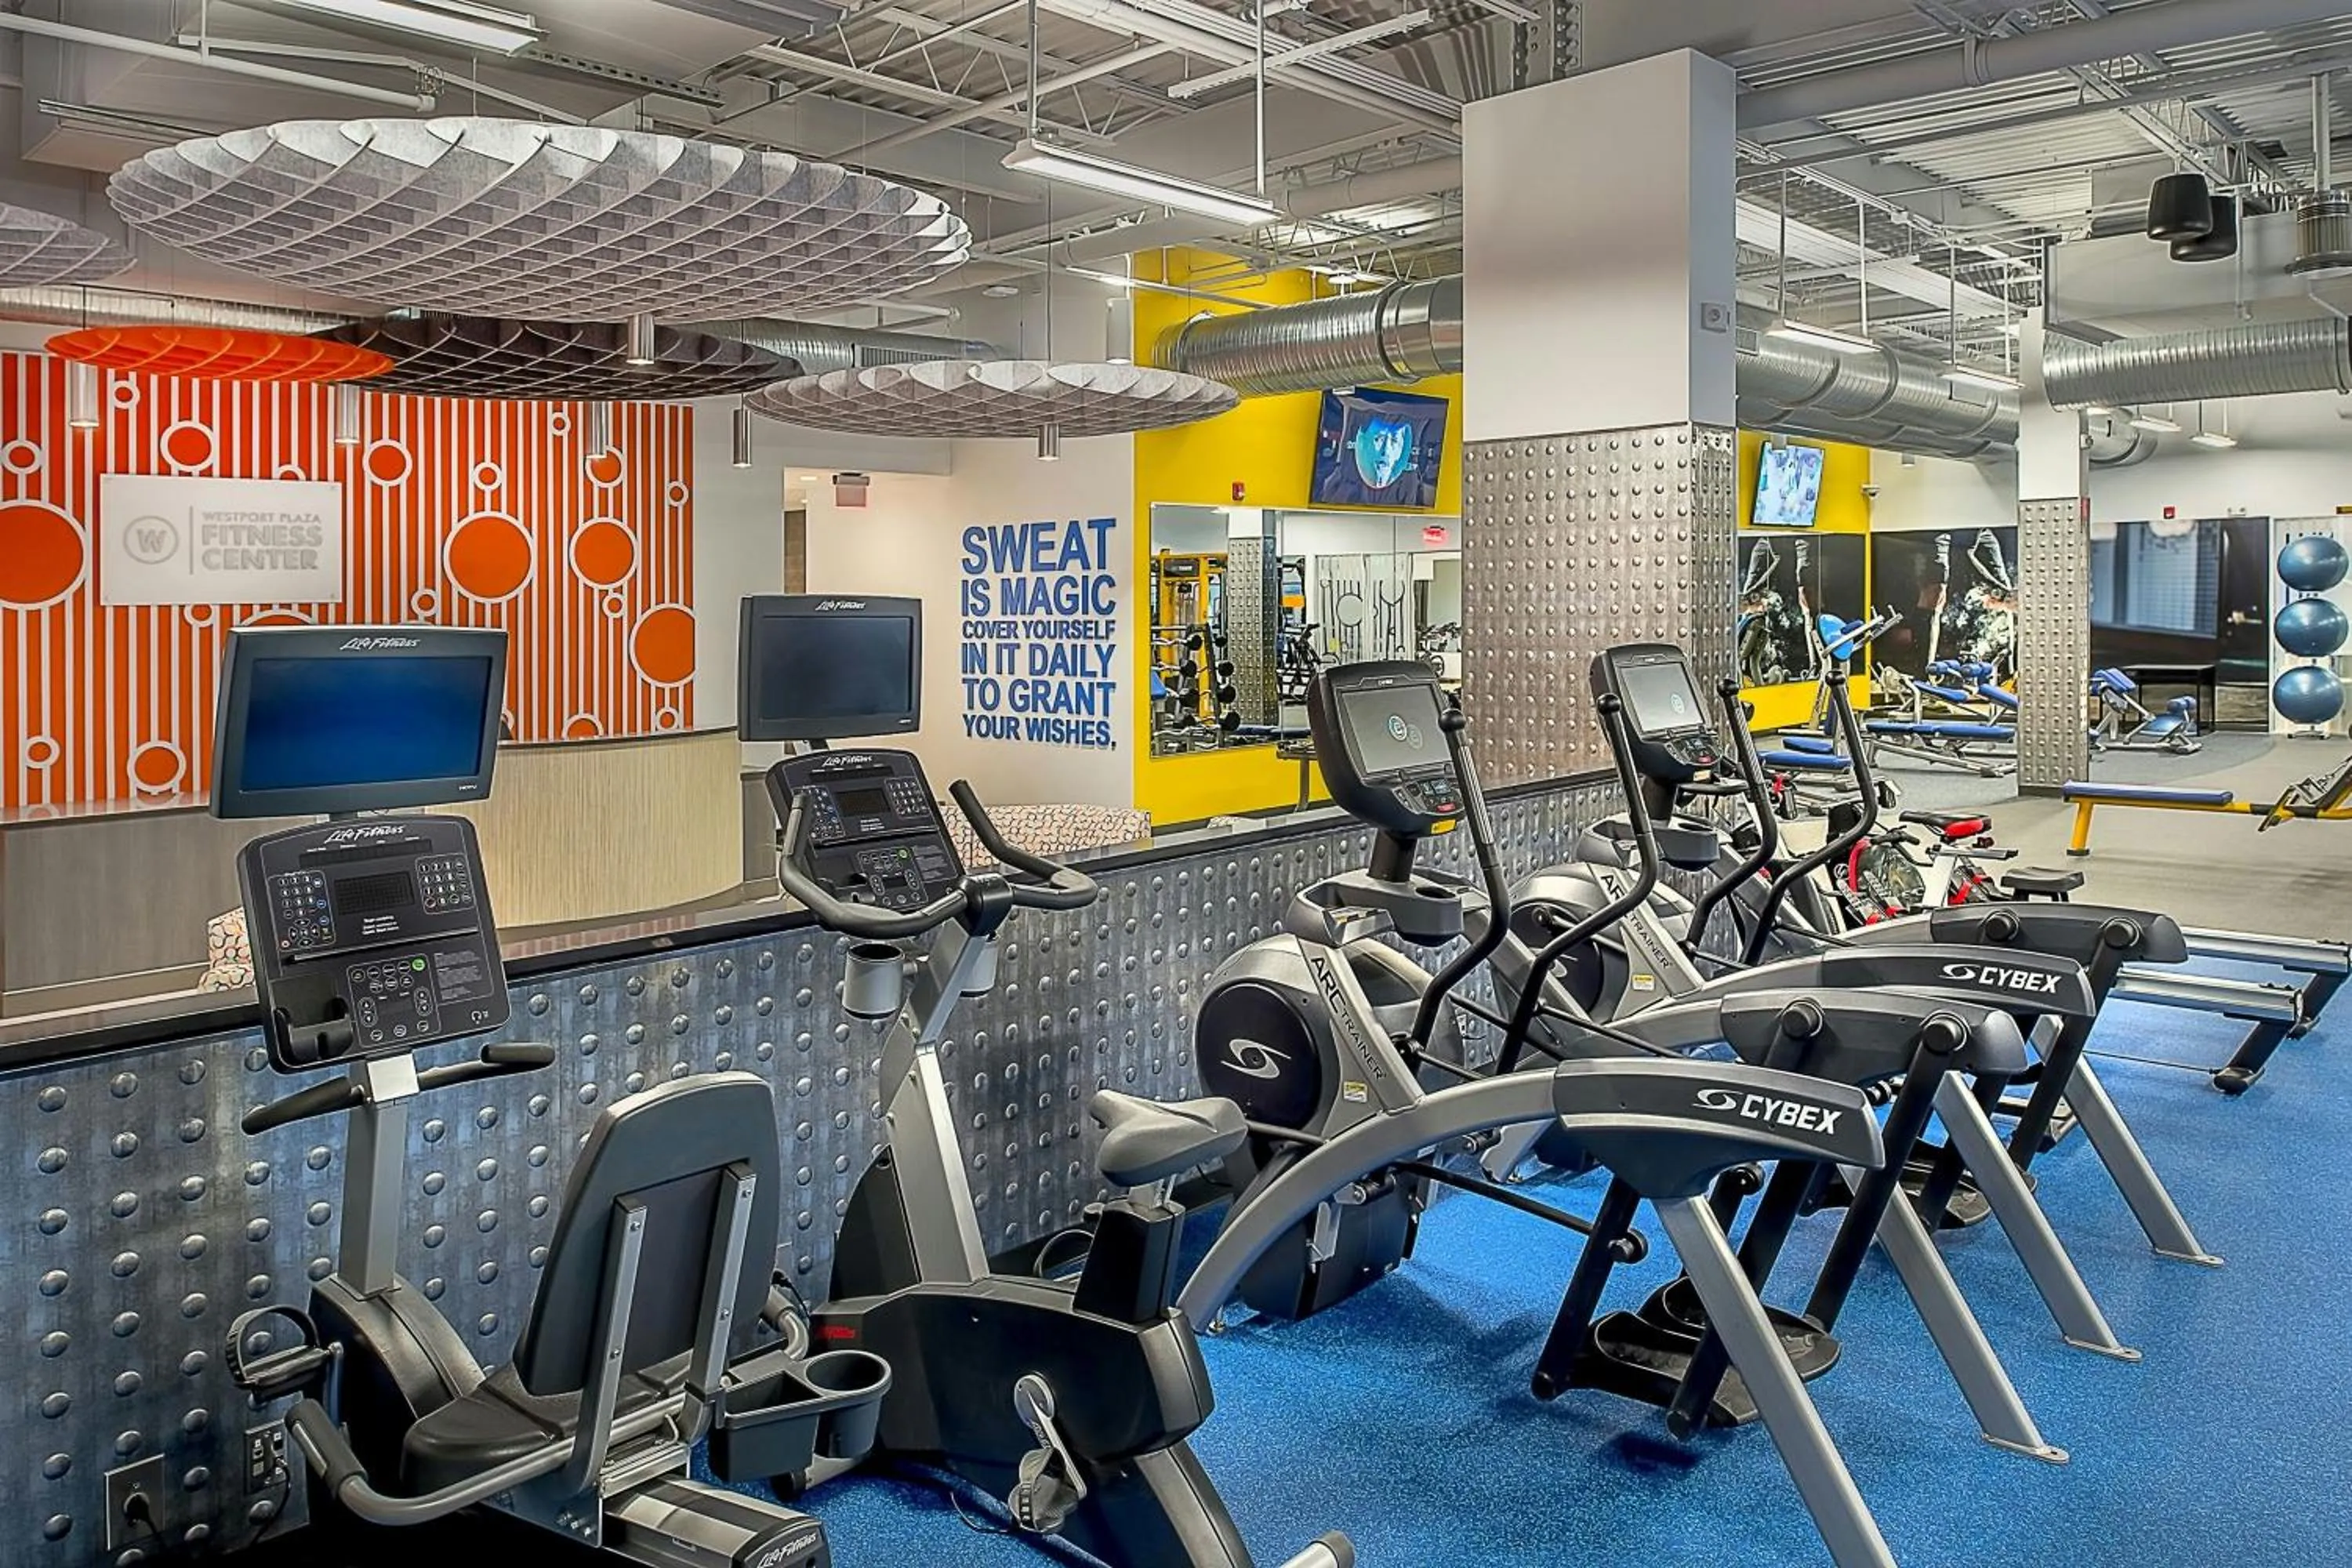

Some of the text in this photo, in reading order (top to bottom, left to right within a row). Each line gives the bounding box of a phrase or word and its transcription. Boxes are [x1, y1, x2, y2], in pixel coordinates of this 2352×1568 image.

[201, 512, 321, 524] WESTPORT PLAZA
[201, 524, 324, 547] FITNESS
[201, 548, 319, 572] CENTER
[961, 517, 1116, 575] SWEAT
[961, 575, 1116, 617] IS MAGIC
[962, 620, 1116, 641] COVER YOURSELF
[961, 643, 1116, 678] IN IT DAILY
[961, 678, 1116, 717] TO GRANT
[962, 714, 1021, 741] YOUR
[1630, 914, 1670, 968] TRAINER
[1311, 956, 1346, 1014] ARC
[1978, 966, 2062, 994] CYBEX
[1739, 1094, 1842, 1135] CYBEX
